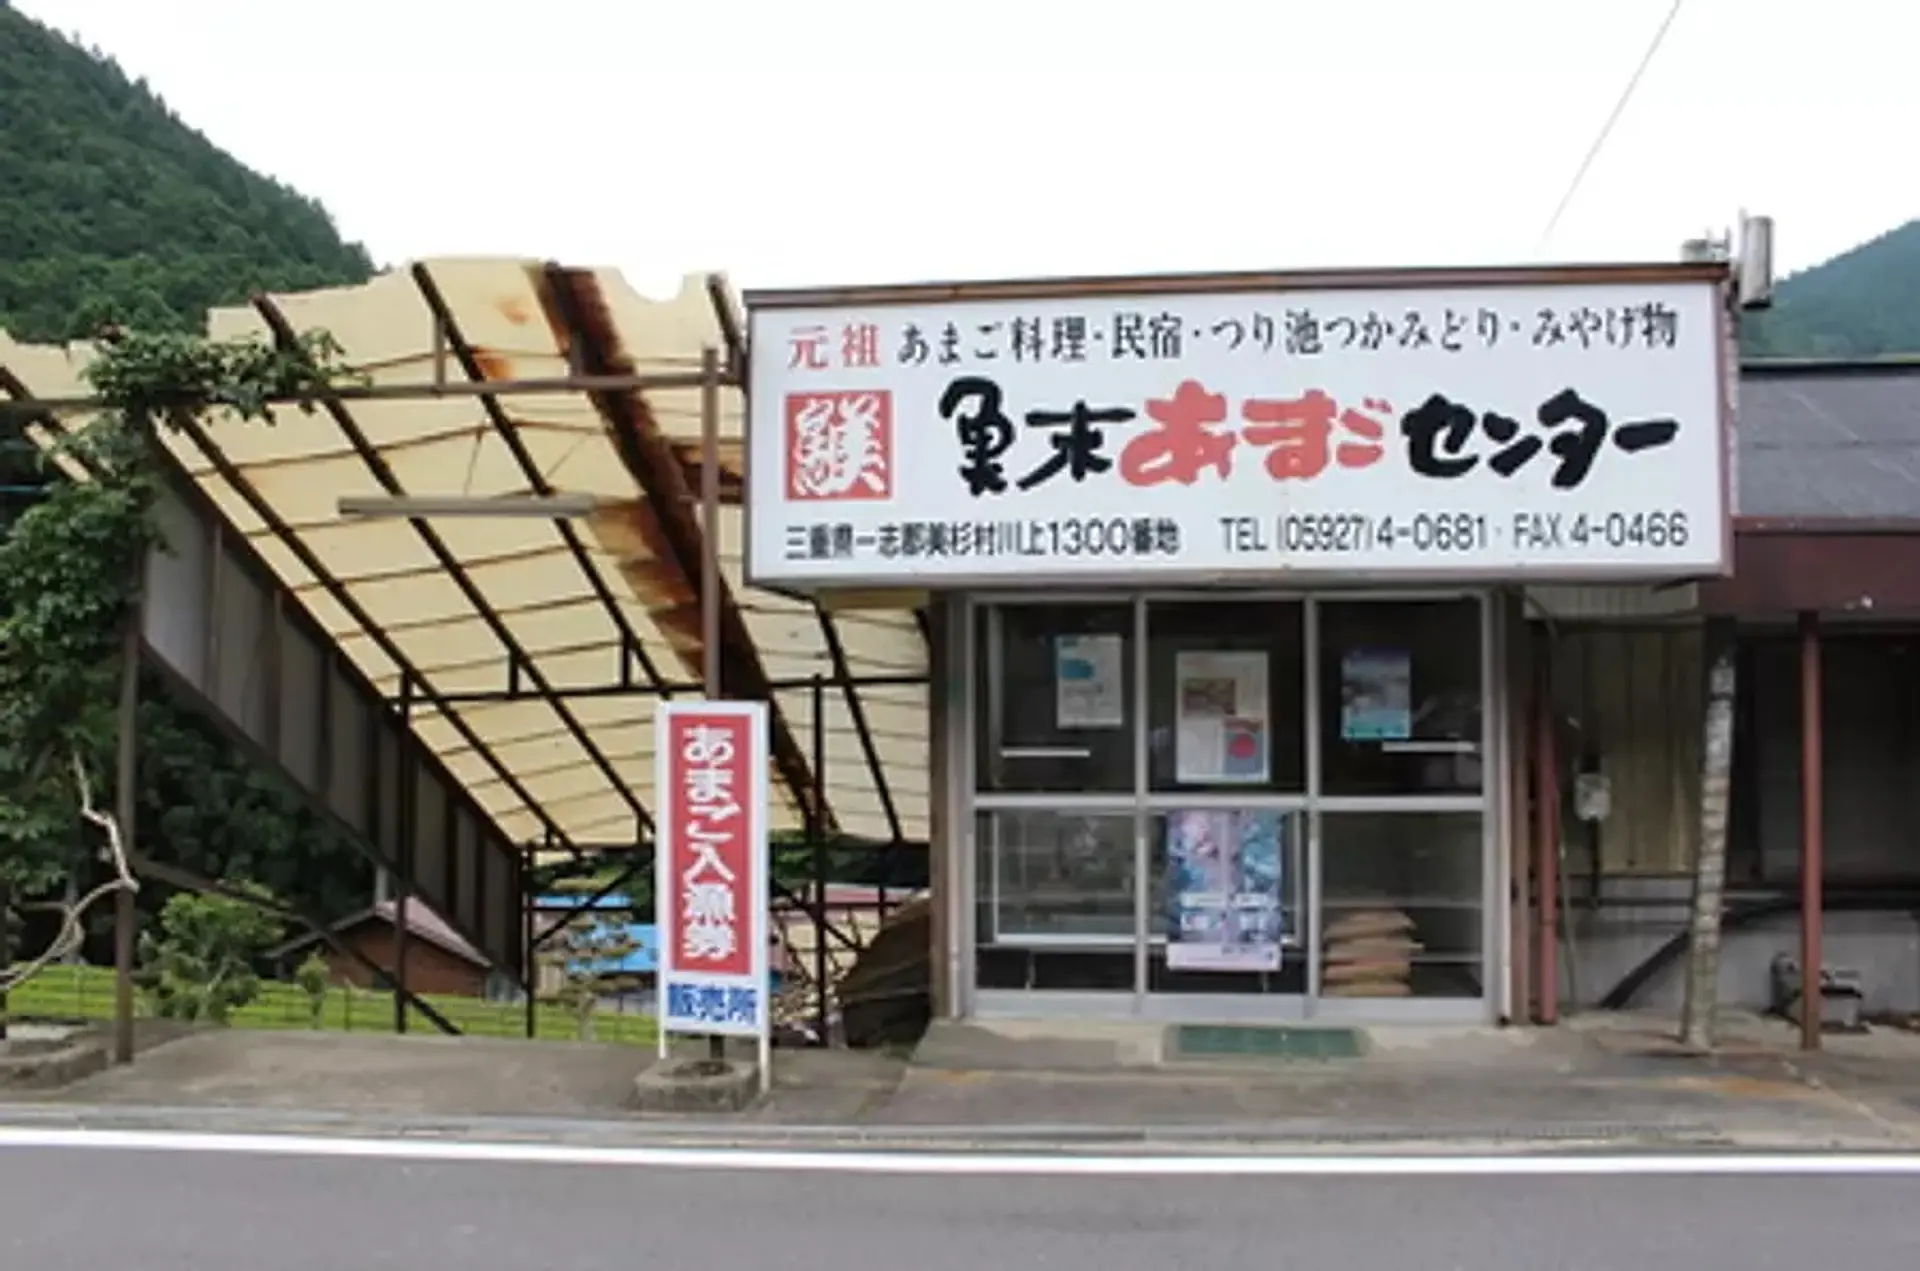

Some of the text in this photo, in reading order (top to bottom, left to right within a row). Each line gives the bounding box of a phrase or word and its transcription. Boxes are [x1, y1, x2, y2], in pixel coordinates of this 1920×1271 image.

[788, 323, 880, 371] 元祖
[786, 517, 1180, 560] 三重県一志郡美杉村川上1300番地
[1219, 516, 1269, 552] TEL
[1513, 512, 1562, 549] FAX
[1570, 511, 1690, 548] 4-0466
[682, 724, 741, 961] あまご入漁券
[667, 983, 757, 1024] 販売所
